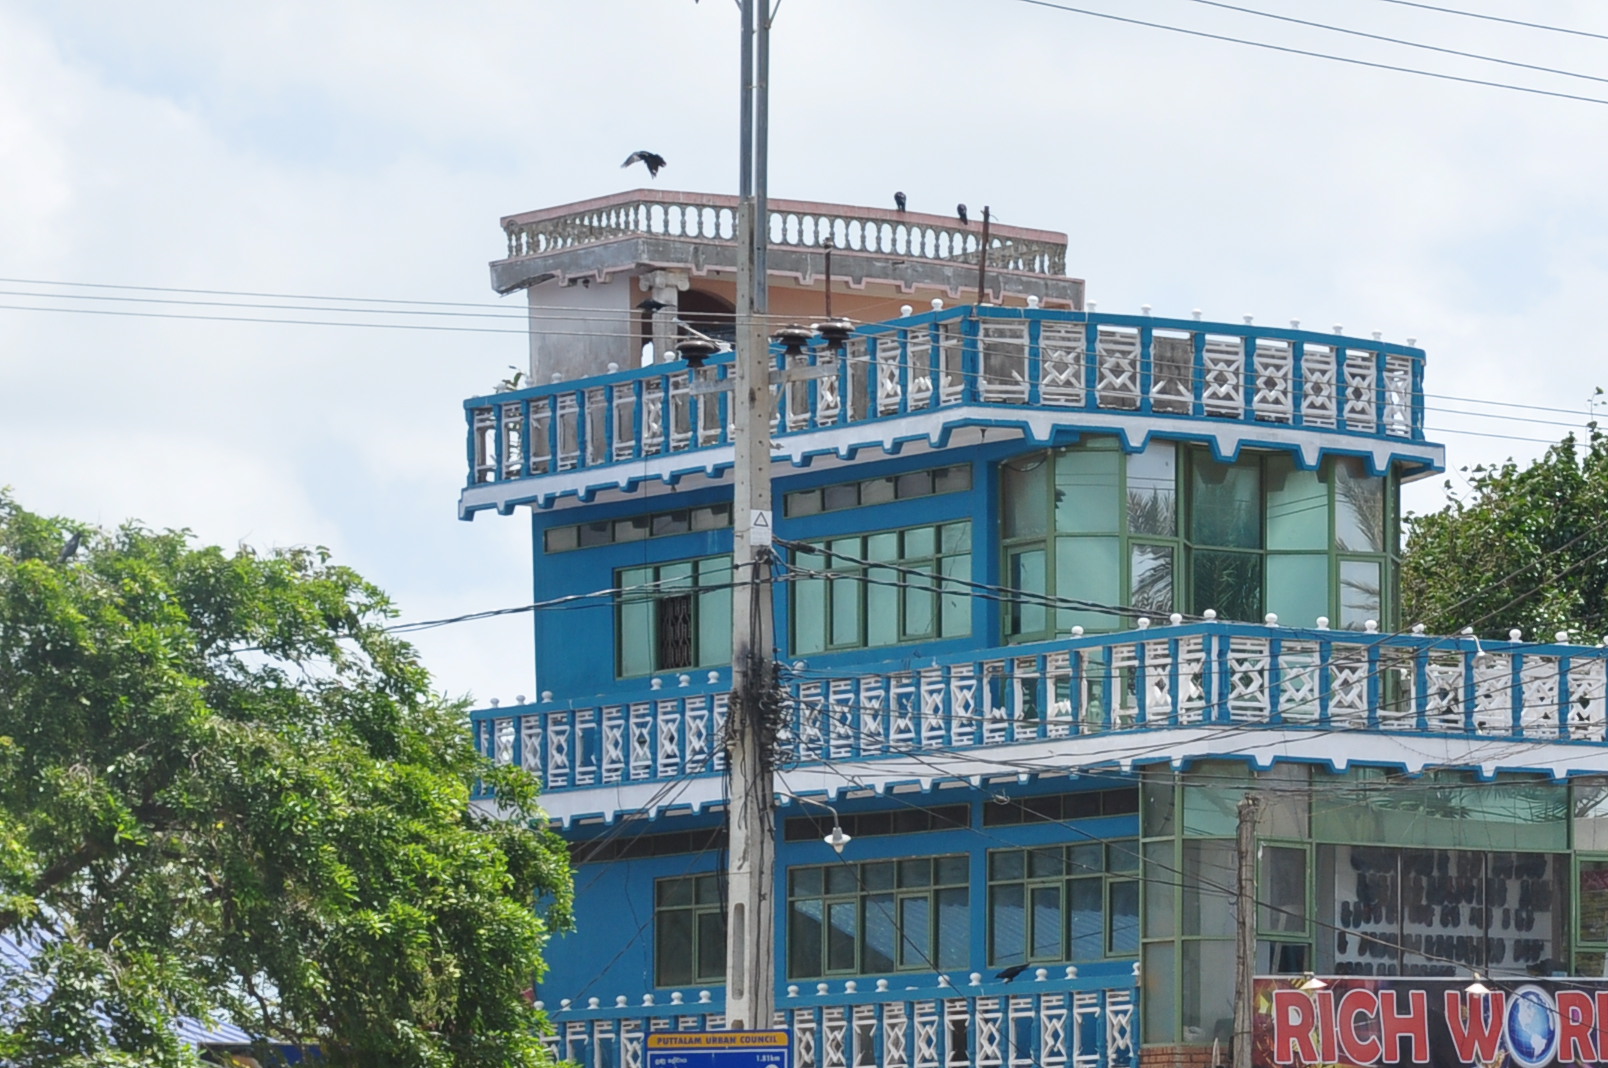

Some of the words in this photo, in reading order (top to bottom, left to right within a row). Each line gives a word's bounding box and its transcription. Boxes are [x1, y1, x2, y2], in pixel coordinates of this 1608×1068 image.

[658, 1037, 702, 1045] PUTTALAM
[706, 1036, 736, 1044] URBAN
[740, 1036, 778, 1044] COUNCIL
[1272, 988, 1431, 1066] RICH
